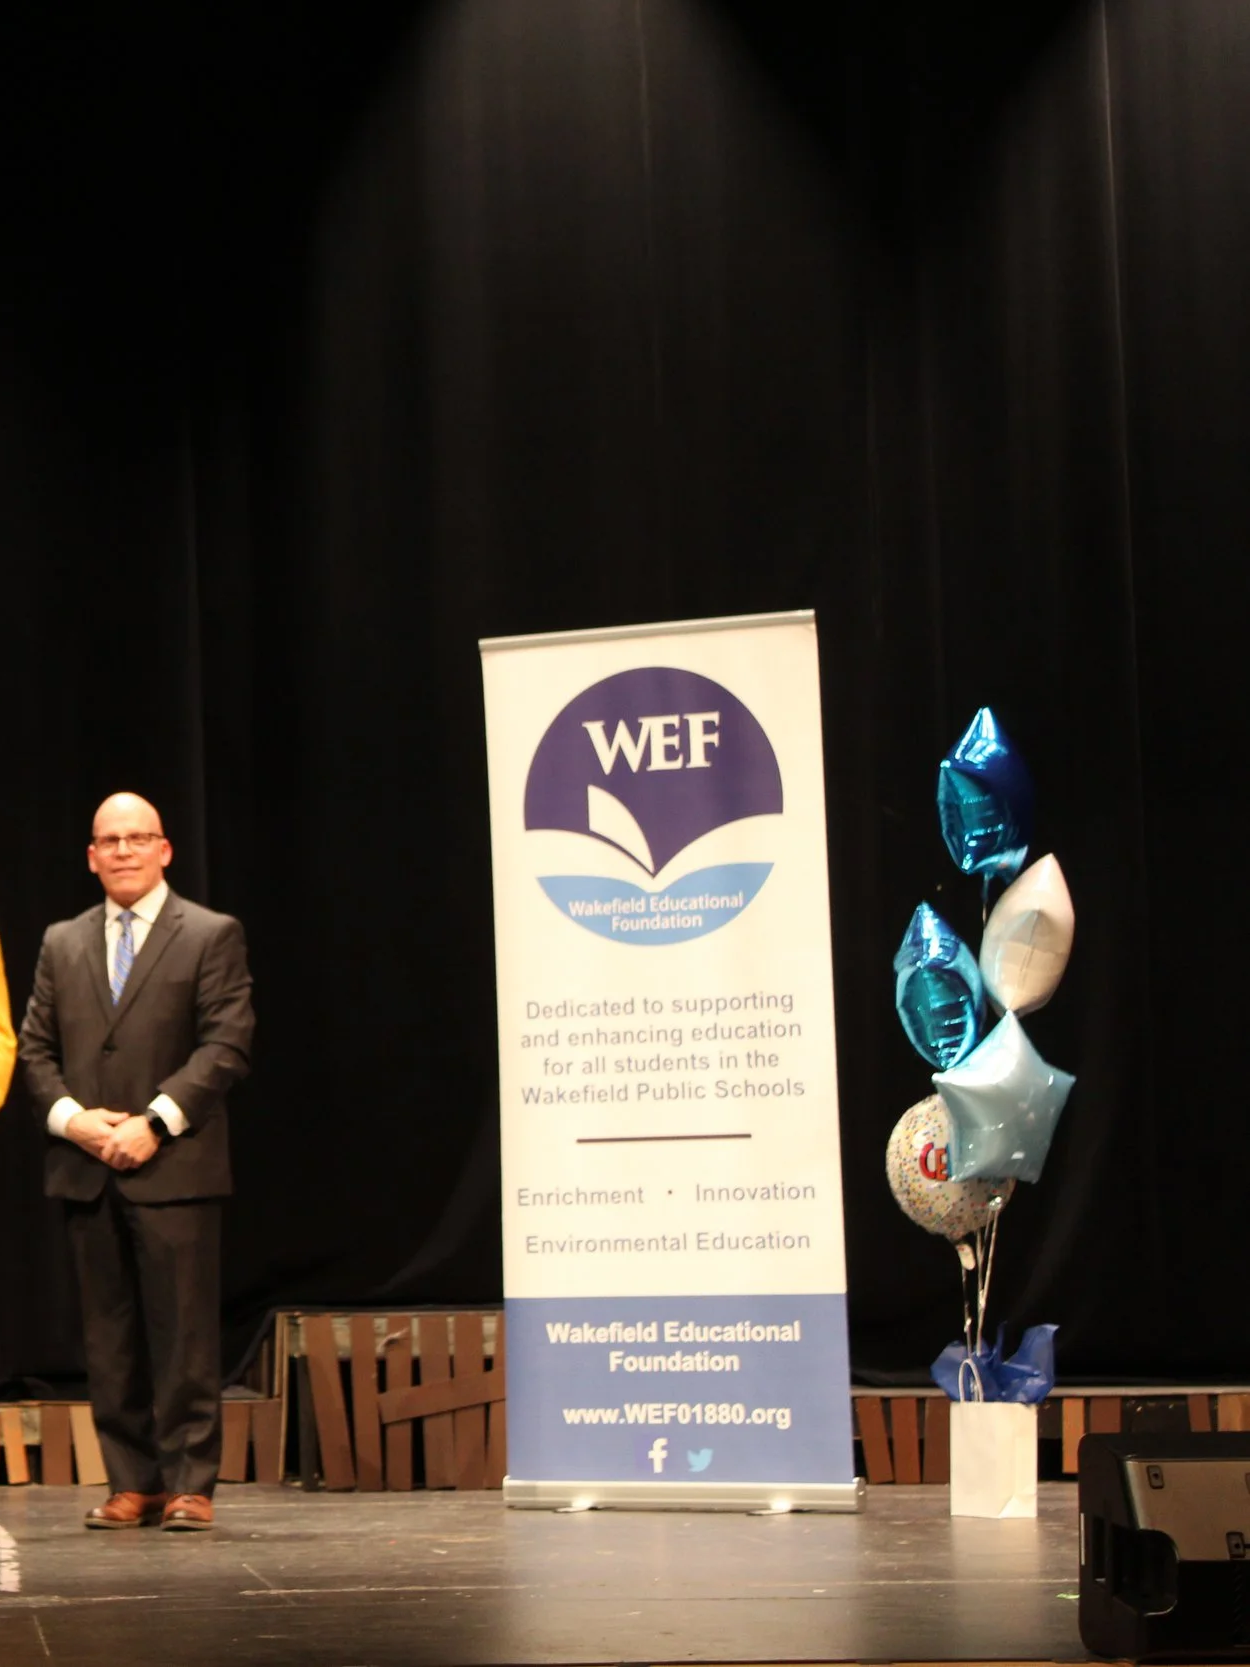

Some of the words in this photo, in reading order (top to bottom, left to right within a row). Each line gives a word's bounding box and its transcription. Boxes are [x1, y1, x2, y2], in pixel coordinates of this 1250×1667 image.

[582, 711, 720, 775] WEF
[568, 897, 646, 917] Wakefield
[650, 891, 744, 913] Educational
[611, 914, 703, 933] Foundation
[526, 997, 635, 1020] Dedicated
[644, 997, 664, 1015] to
[672, 991, 794, 1016] supporting
[520, 1030, 559, 1049] and
[568, 1024, 684, 1047] enhancing
[691, 1020, 802, 1042] education
[543, 1057, 573, 1076] for
[582, 1056, 606, 1075] all
[614, 1052, 710, 1073] students
[719, 1051, 738, 1070] in
[746, 1050, 779, 1069] the
[521, 1084, 629, 1106] Wakefield
[636, 1081, 706, 1101] Public
[714, 1078, 806, 1099] Schools
[517, 1187, 644, 1207] Enrichment
[696, 1181, 816, 1202] Innovation
[526, 1233, 687, 1254] Environmental
[696, 1230, 811, 1251] Education
[546, 1321, 658, 1344] Wakefield
[664, 1320, 801, 1343] Educational
[609, 1351, 740, 1373] Foundation
[562, 1403, 792, 1430] www.WEF01880.org
[648, 1437, 668, 1474] f
